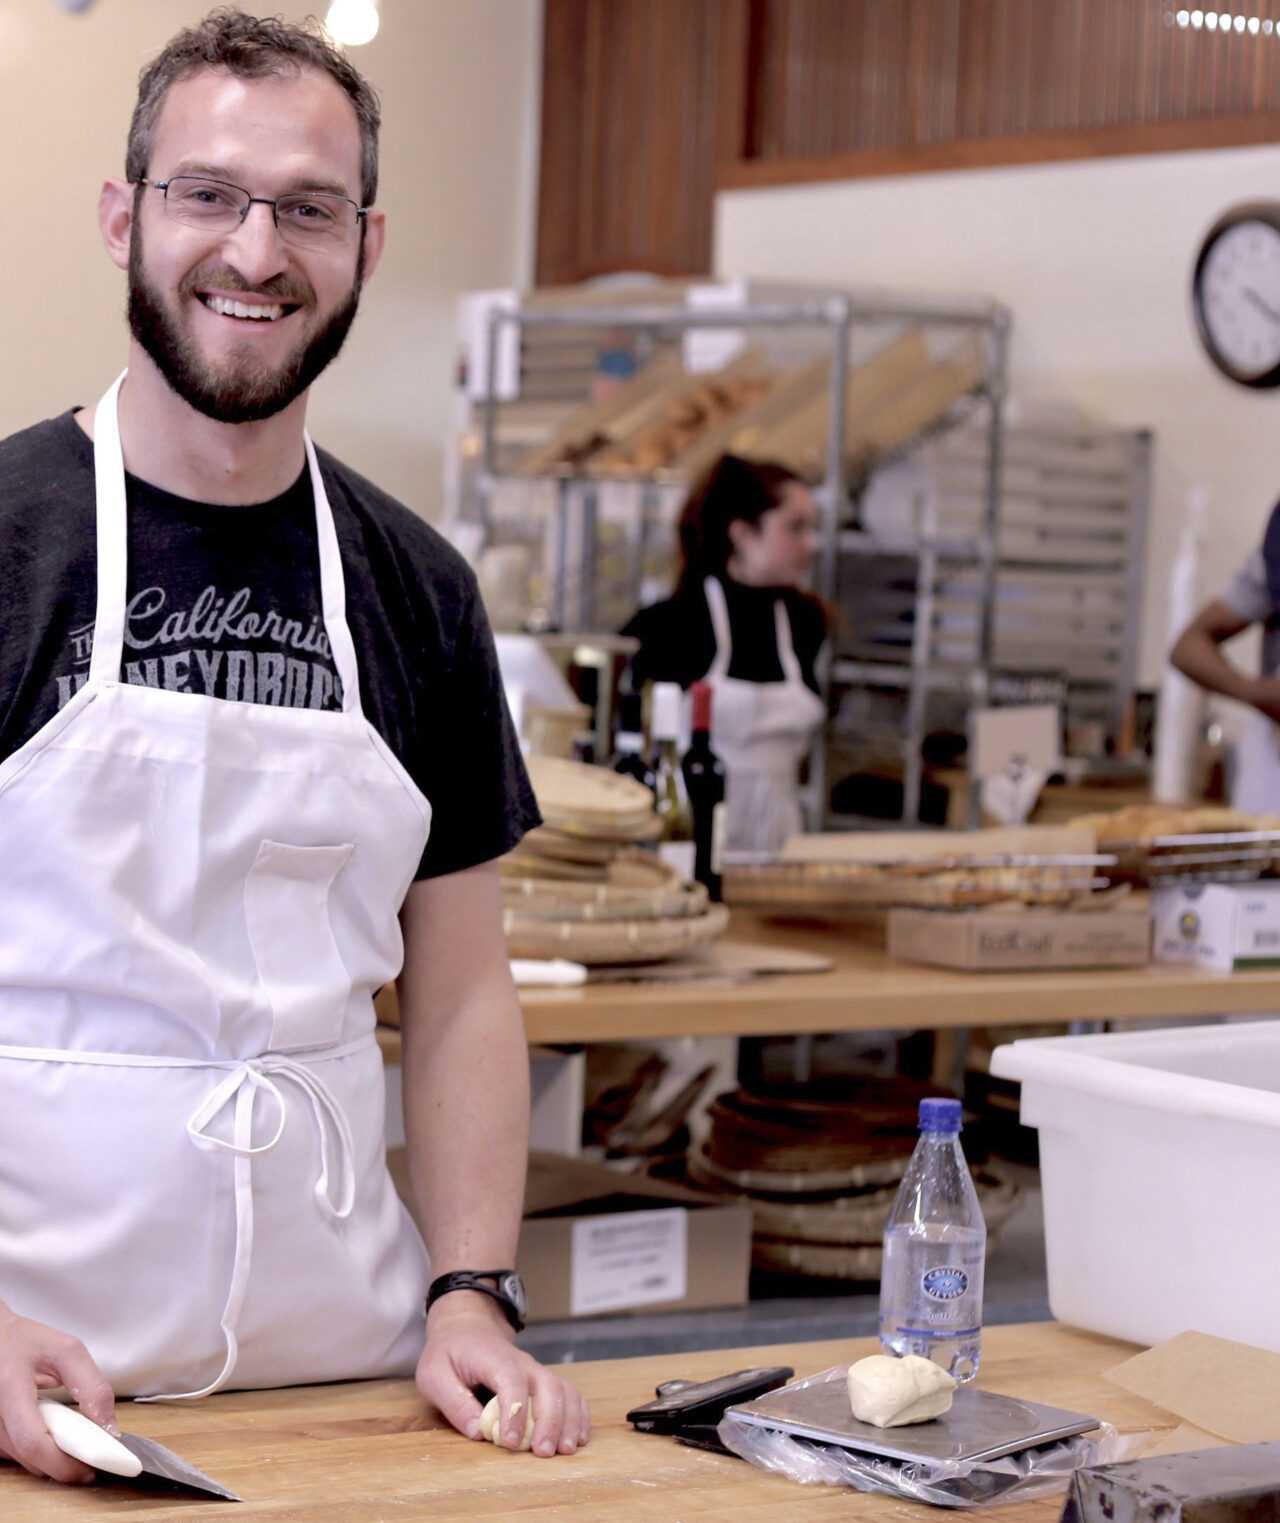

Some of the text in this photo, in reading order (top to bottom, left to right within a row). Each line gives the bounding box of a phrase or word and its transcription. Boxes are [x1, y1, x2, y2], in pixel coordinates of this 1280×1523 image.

[123, 585, 333, 660] California
[71, 633, 93, 659] TH
[927, 1267, 965, 1281] CRYSTAL
[928, 1286, 964, 1299] GEYSER
